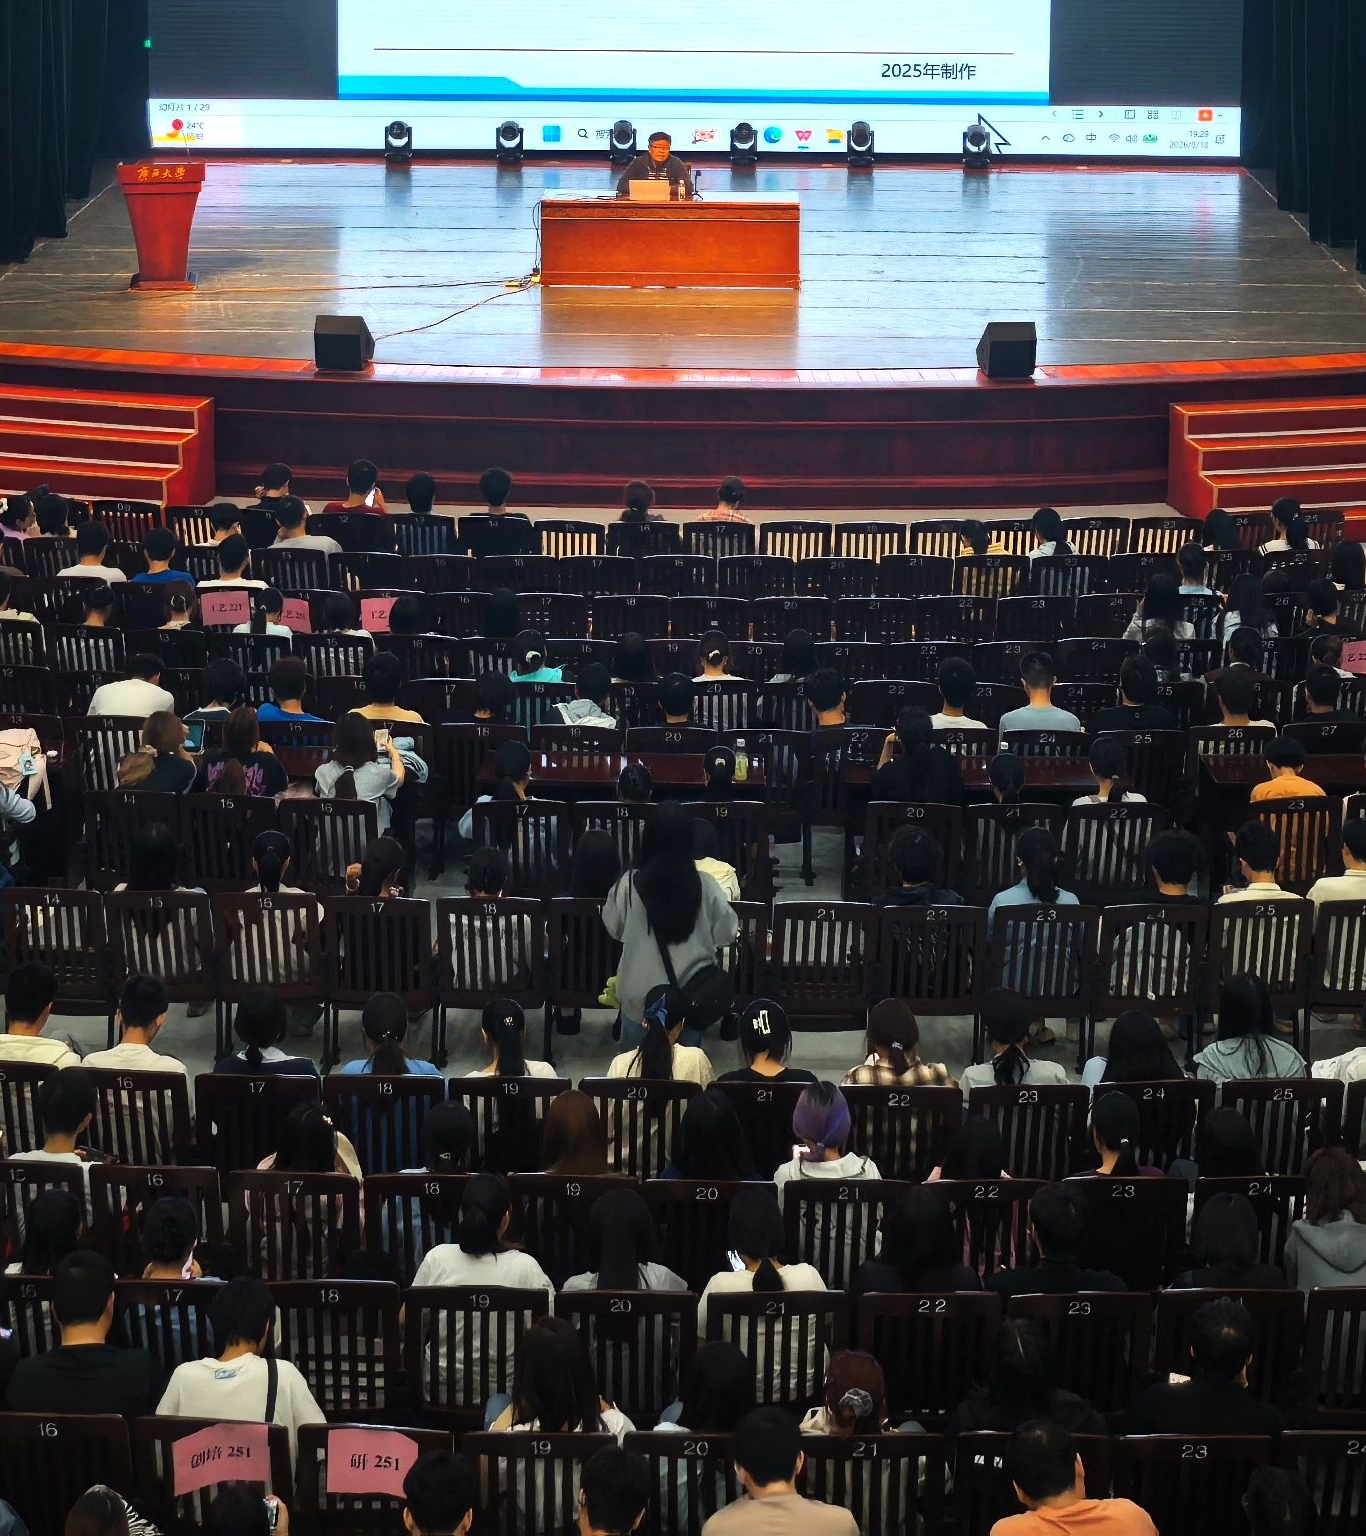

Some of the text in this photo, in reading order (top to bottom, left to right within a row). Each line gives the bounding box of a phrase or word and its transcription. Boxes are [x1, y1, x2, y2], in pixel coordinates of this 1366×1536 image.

[881, 61, 977, 83] 2025年制作
[534, 682, 545, 694] 18
[706, 682, 723, 694] 20
[477, 725, 490, 737] 18
[665, 730, 682, 742] 20
[1321, 724, 1338, 736] 27
[1039, 732, 1056, 744] 24
[1133, 733, 1153, 745] 25
[320, 802, 333, 814] 16
[514, 802, 530, 816] 17
[715, 806, 728, 818] 19
[1109, 807, 1128, 819] 22
[257, 897, 273, 909] 16
[370, 901, 385, 913] 17
[482, 902, 497, 915] 18
[1255, 904, 1276, 916] 25
[817, 908, 835, 921] 21
[926, 909, 948, 921] 22
[1035, 909, 1057, 921] 23
[116, 1075, 134, 1089] 16
[248, 1080, 267, 1094] 17
[379, 1082, 393, 1095] 18
[502, 1082, 519, 1095] 19
[626, 1087, 648, 1100] 20
[756, 1089, 773, 1103] 21
[887, 1092, 910, 1107] 22
[1018, 1090, 1039, 1104] 23
[1142, 1087, 1165, 1100] 24
[1273, 1087, 1294, 1101] 25
[147, 1173, 164, 1187] 16
[283, 1180, 304, 1195] 17
[424, 1182, 440, 1195] 18
[566, 1182, 581, 1197] 19
[695, 1187, 719, 1200] 20
[838, 1186, 859, 1200] 21
[974, 1185, 999, 1199] 22
[1111, 1184, 1135, 1199] 23
[1248, 1181, 1272, 1196] 24
[164, 1288, 184, 1303] 17
[320, 1288, 339, 1304] 18
[469, 1294, 490, 1309] 19
[610, 1298, 632, 1313] 20
[765, 1300, 785, 1315] 21
[918, 1298, 946, 1313] 22
[1068, 1301, 1091, 1315] 23
[40, 1422, 58, 1437] 16
[227, 1445, 252, 1459] 251
[530, 1440, 552, 1455] 19
[683, 1440, 709, 1456] 20
[852, 1441, 877, 1457] 21
[1181, 1444, 1208, 1460] 23
[373, 1454, 400, 1472] 251
